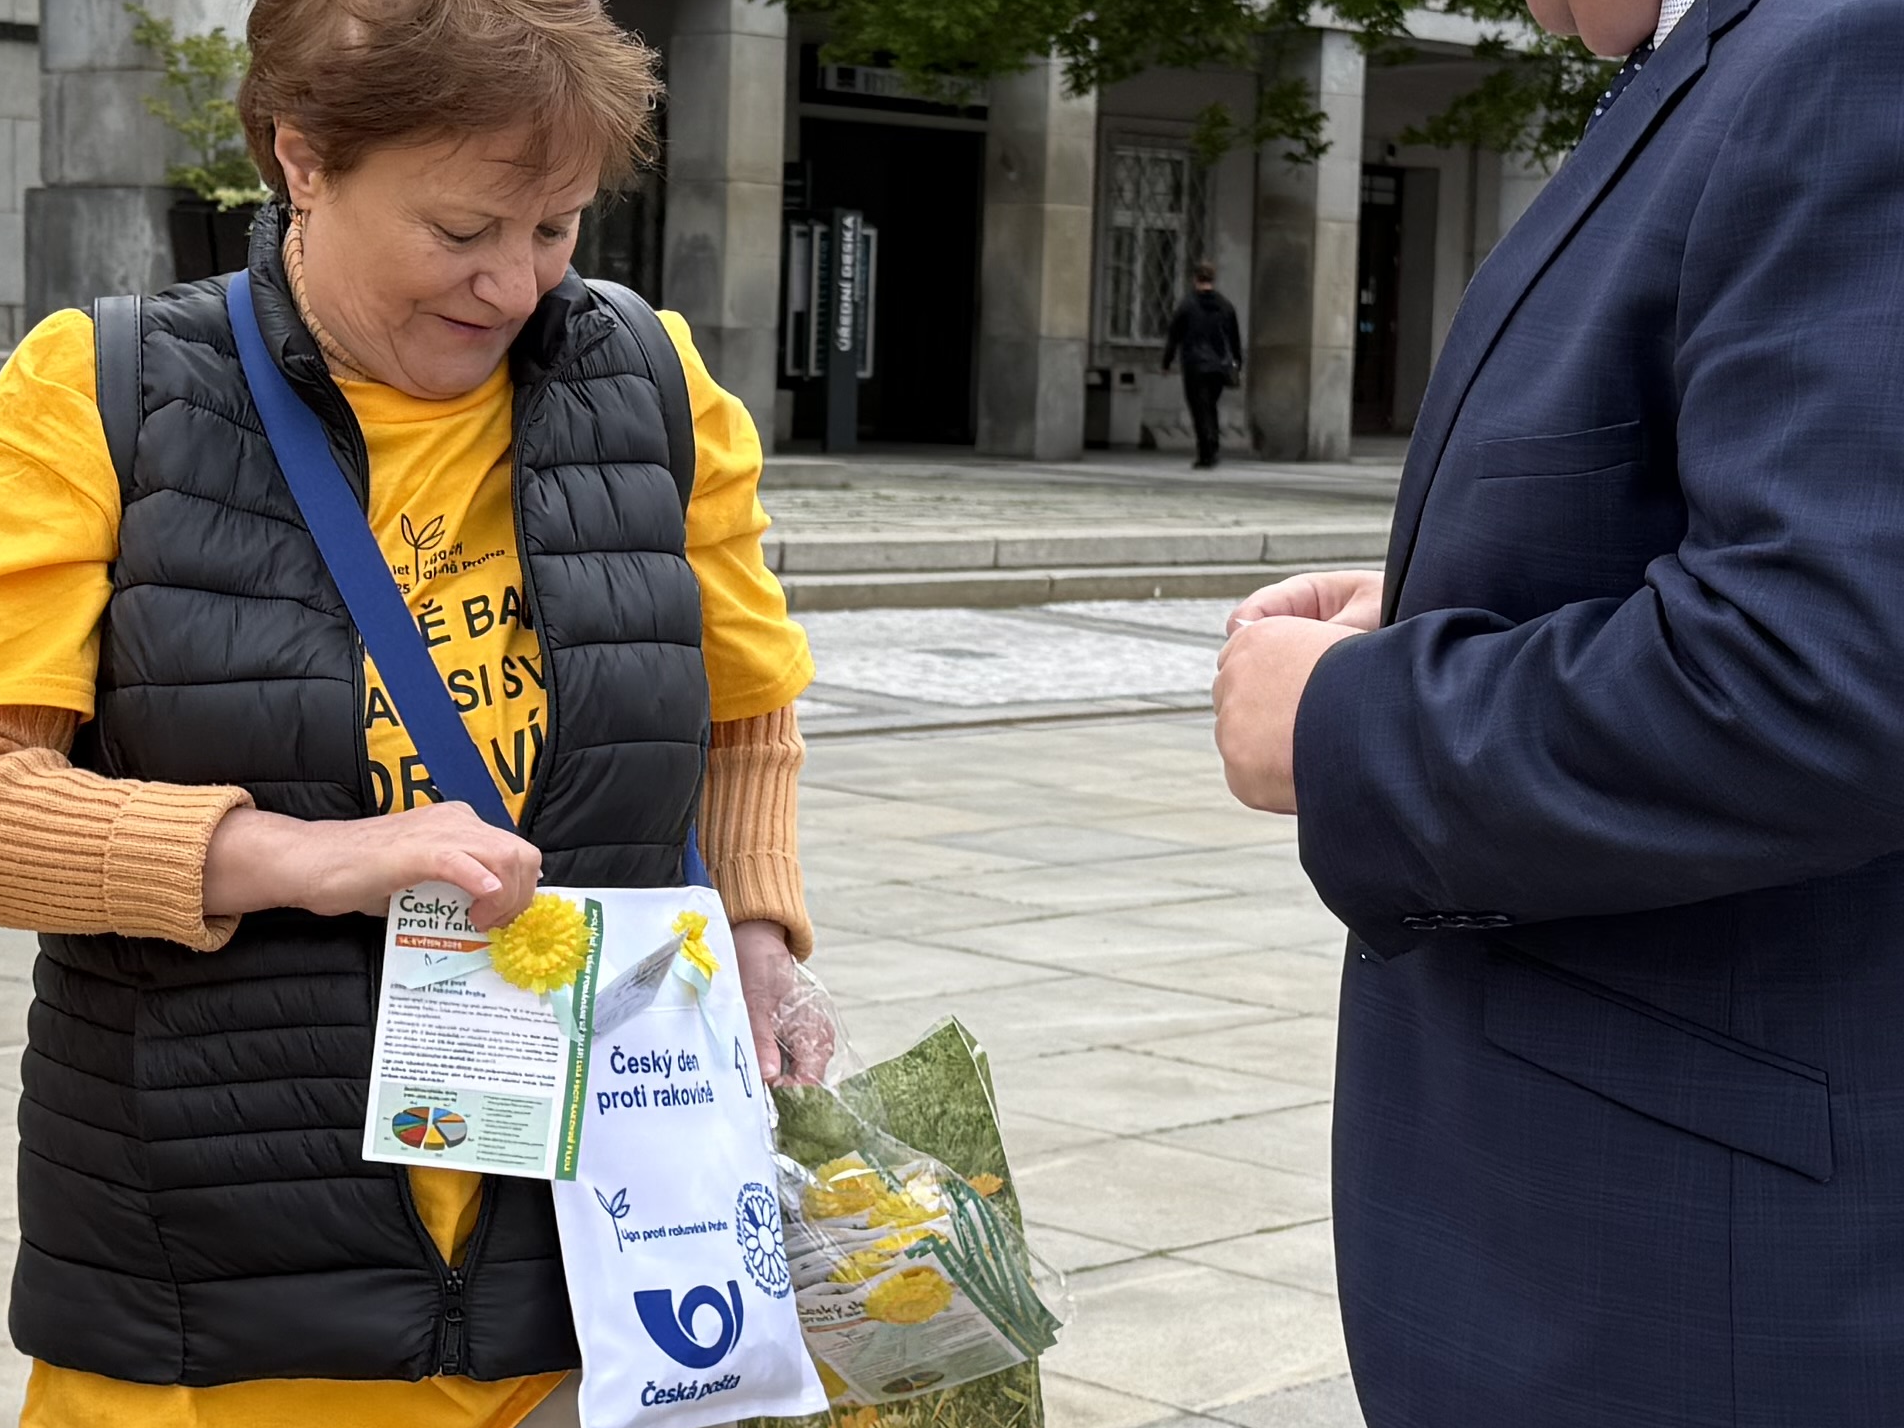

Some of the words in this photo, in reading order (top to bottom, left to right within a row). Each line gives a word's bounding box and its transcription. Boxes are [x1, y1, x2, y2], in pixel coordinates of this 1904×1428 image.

[841, 216, 855, 278] DESKA
[417, 598, 451, 648] Ě
[447, 664, 493, 713] SI
[502, 655, 547, 699] SV
[399, 889, 459, 921] Český
[397, 916, 439, 930] proti
[610, 1045, 672, 1079] Český
[677, 1048, 700, 1072] den
[596, 1084, 647, 1115] proti
[641, 1380, 698, 1407] Česká
[696, 1374, 741, 1401] pošta
